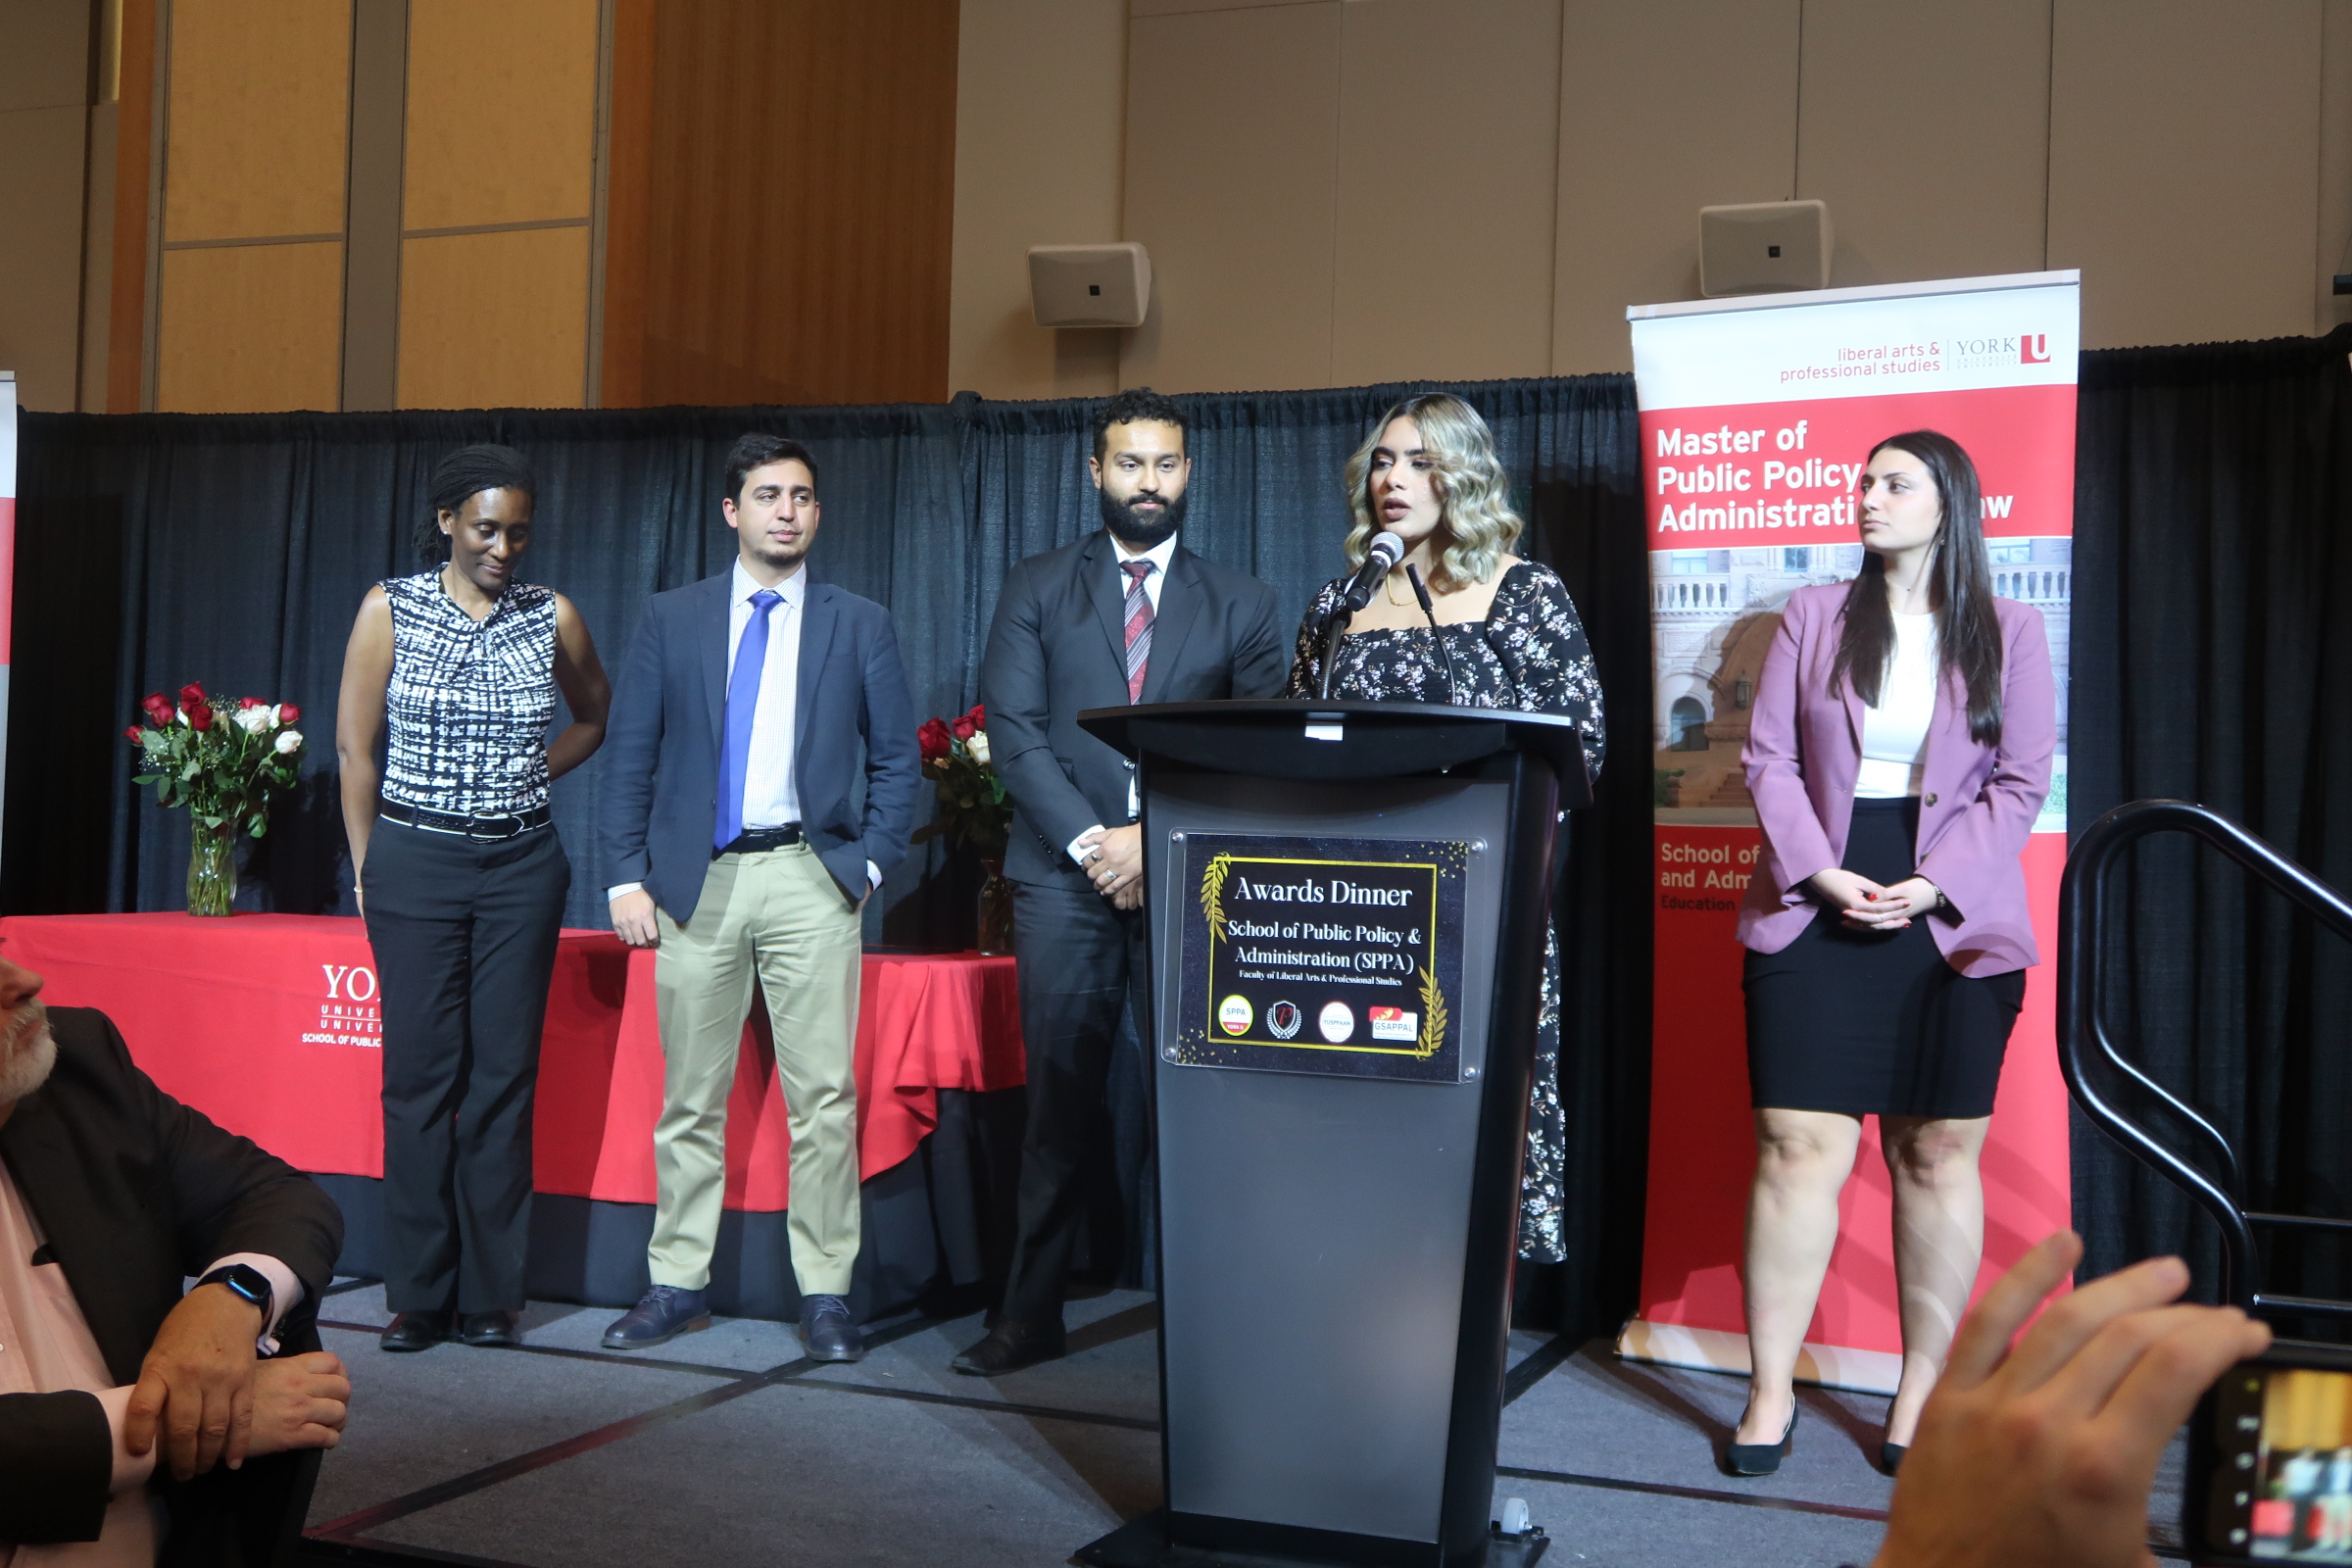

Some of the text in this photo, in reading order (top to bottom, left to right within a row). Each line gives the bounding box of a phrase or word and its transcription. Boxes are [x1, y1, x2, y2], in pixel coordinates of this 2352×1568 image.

[1838, 342, 1940, 361] liberal arts &
[1956, 337, 2017, 355] YORK
[1781, 359, 1940, 383] professional studies
[1657, 419, 1808, 458] Master of
[1657, 458, 1862, 495] Public Policy
[1658, 495, 1855, 533] Administrati
[1661, 843, 1761, 864] School of
[1661, 869, 1695, 888] and
[1235, 876, 1413, 906] Awards Dinner
[1661, 896, 1736, 911] Education
[1228, 919, 1422, 948] School of Public Policy &
[1235, 947, 1414, 975] Administration (SPPA)
[321, 964, 381, 1002] YO
[1239, 969, 1265, 980] Faculty
[1276, 971, 1303, 981] Liberal
[1304, 973, 1320, 982] Arts
[1329, 975, 1375, 985] Professional
[1376, 976, 1402, 986] Studies
[1375, 1022, 1413, 1032] GSAPPAL
[302, 1033, 382, 1048] SCHOOL OF PUBLIC
